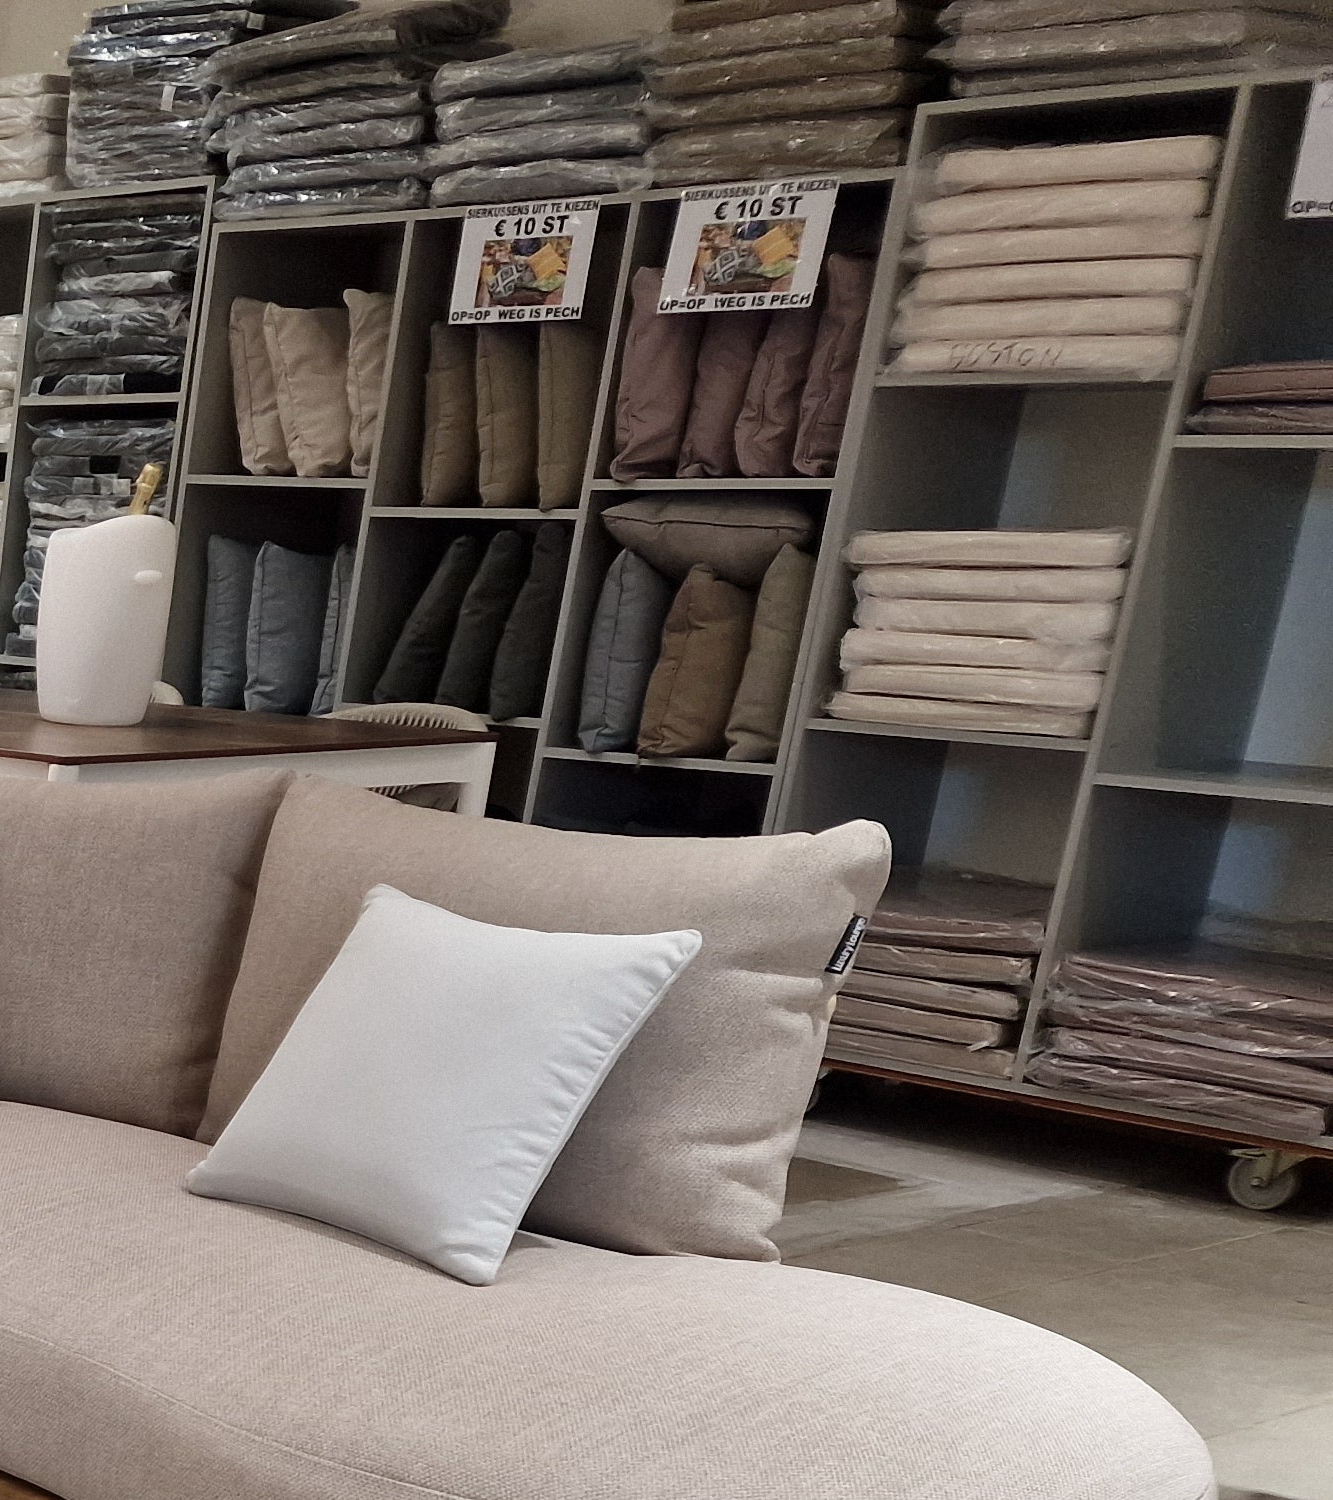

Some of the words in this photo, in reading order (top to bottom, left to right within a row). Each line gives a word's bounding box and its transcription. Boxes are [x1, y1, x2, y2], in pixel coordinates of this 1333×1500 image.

[782, 181, 794, 194] TE
[467, 204, 530, 220] SIERKUSSENS
[532, 203, 548, 215] UIT
[551, 202, 562, 213] TE
[564, 199, 601, 213] KIEZEN
[714, 201, 729, 220] €
[736, 199, 763, 218] 10
[770, 195, 803, 217] ST
[494, 219, 507, 237] €
[513, 216, 536, 236] 10
[542, 214, 570, 235] ST
[660, 298, 707, 312] OP=OP
[714, 295, 746, 309] WEG
[751, 294, 766, 307] IS
[769, 292, 813, 307] PECH
[451, 310, 491, 323] OP=OP
[498, 308, 526, 321] WEG
[529, 307, 541, 320] IS
[545, 306, 581, 319] PECH
